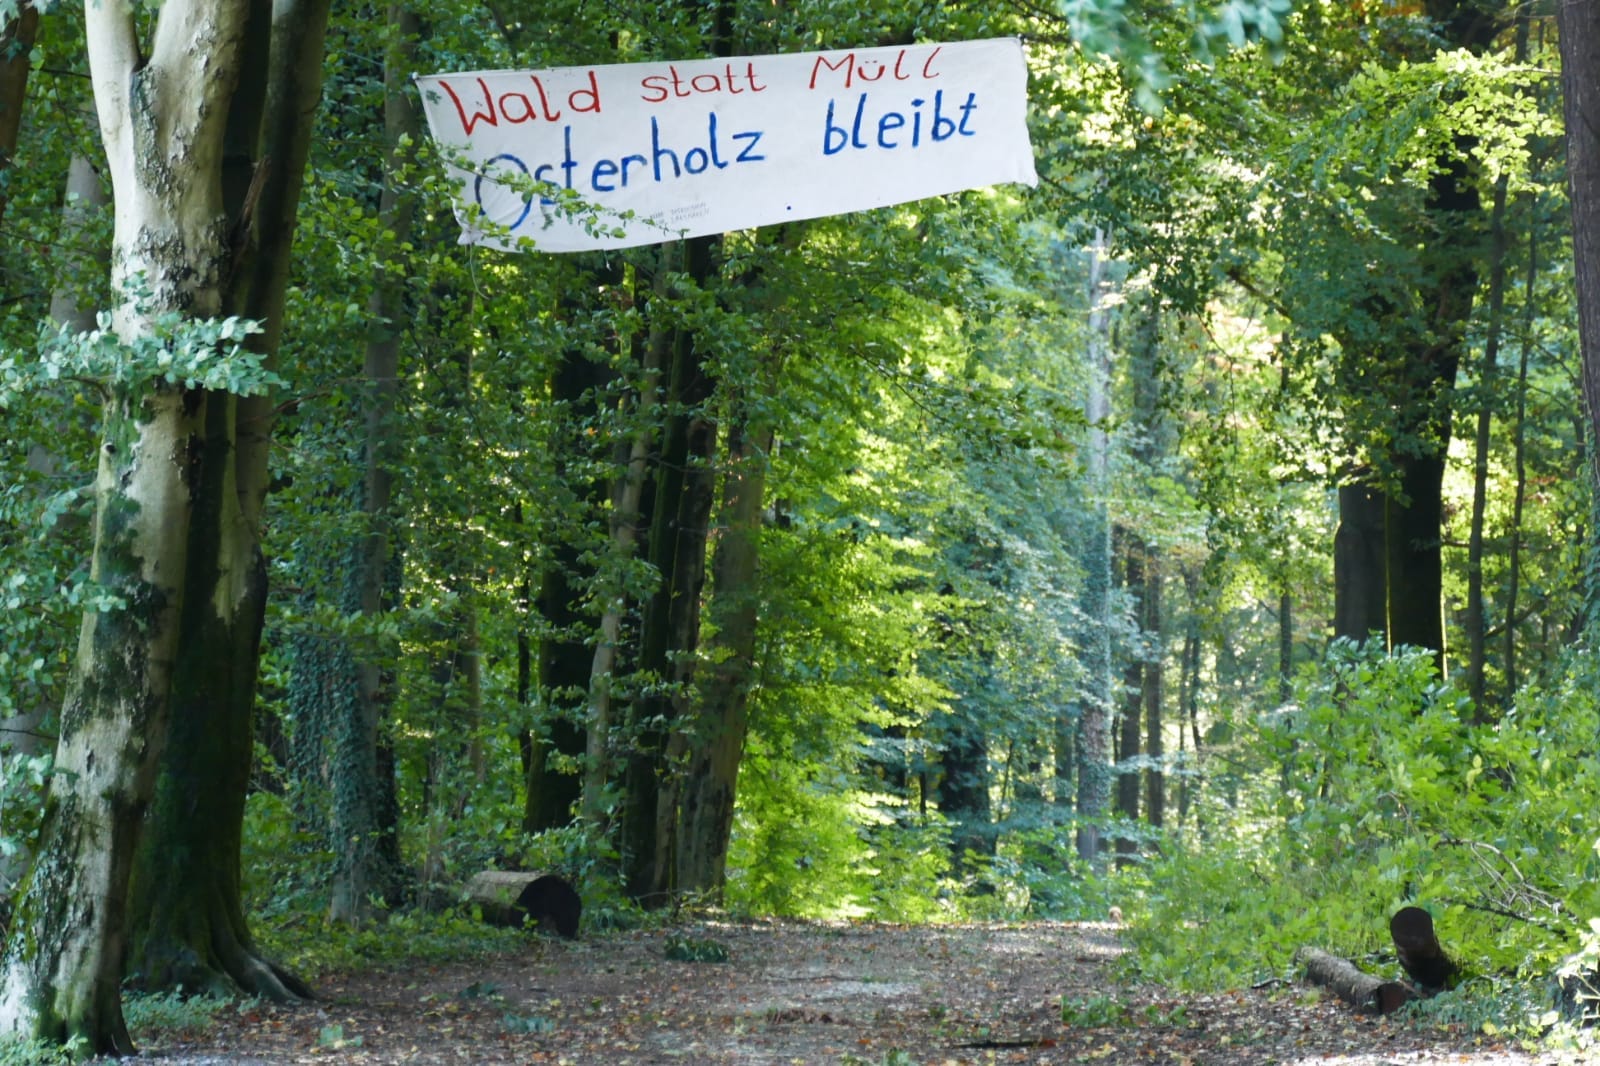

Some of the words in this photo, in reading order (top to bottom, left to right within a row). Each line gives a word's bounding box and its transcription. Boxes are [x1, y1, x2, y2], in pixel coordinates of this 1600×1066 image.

[439, 71, 601, 135] Wald
[641, 63, 767, 103] statt
[809, 47, 941, 89] Müll
[475, 111, 767, 230] Osterholz
[823, 89, 978, 155] bleibt
